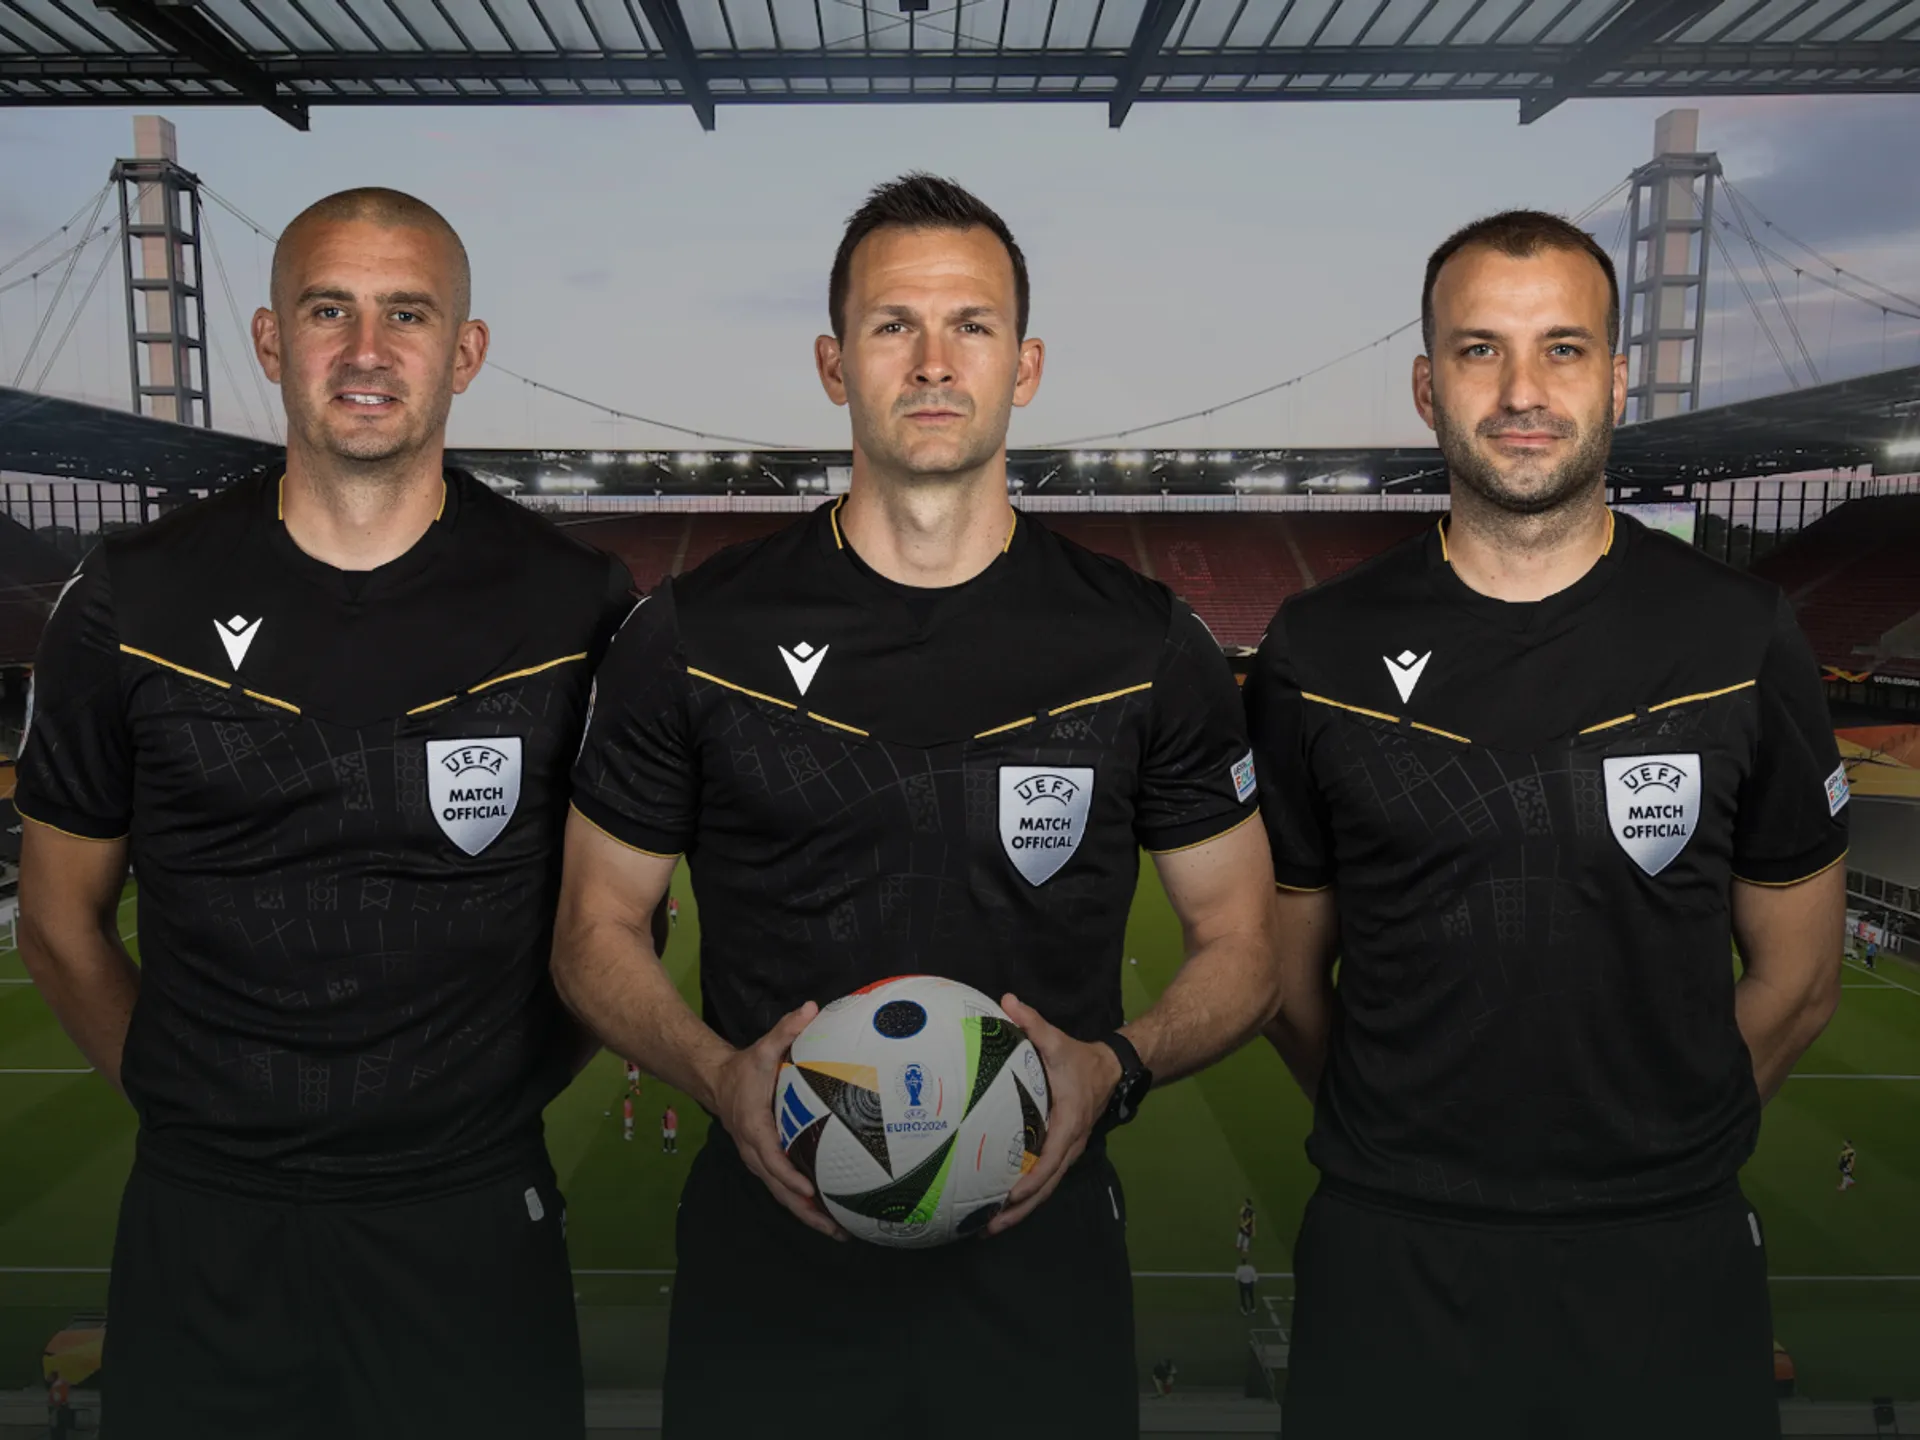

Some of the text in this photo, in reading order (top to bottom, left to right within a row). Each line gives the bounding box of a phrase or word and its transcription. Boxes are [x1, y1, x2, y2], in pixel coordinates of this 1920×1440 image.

[445, 750, 502, 772] UEFA
[1624, 767, 1681, 789] UEFA
[449, 787, 503, 802] MATCH
[1018, 779, 1074, 802] UEFA
[443, 805, 507, 821] OFFICIAL
[1629, 805, 1684, 819] MATCH
[1019, 817, 1072, 831] MATCH
[1623, 824, 1687, 839] OFFICIAL
[1012, 836, 1073, 849] OFFICIAL
